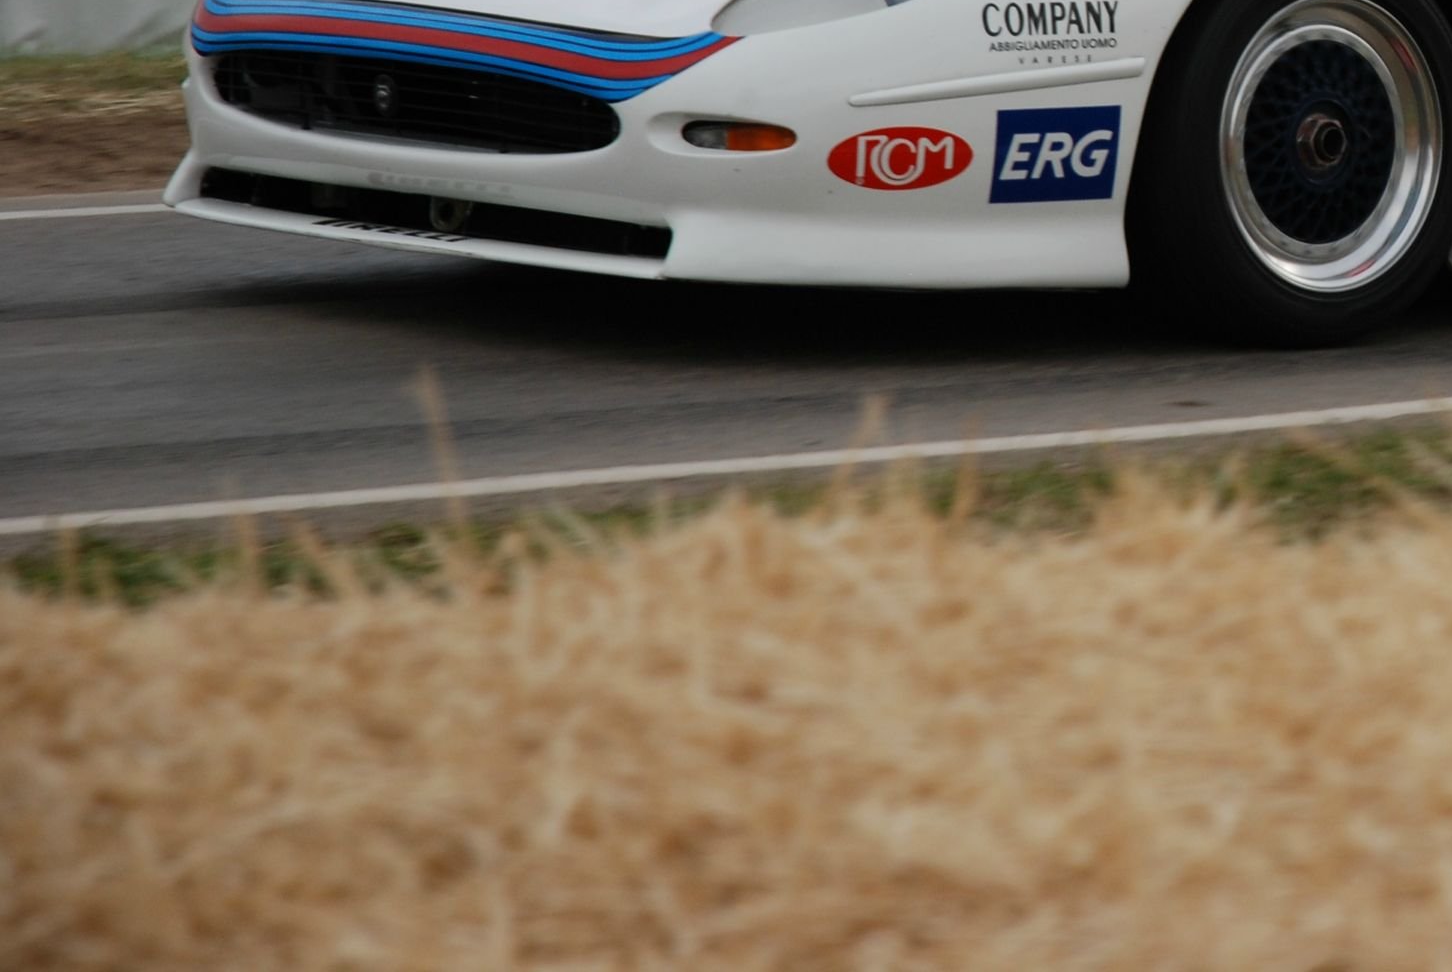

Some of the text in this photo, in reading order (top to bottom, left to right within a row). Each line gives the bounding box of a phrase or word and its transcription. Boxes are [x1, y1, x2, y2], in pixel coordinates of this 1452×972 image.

[982, 0, 1118, 37] COMPANY
[989, 37, 1118, 52] ABBIGLIAMENTO UOMO
[856, 134, 955, 185] RCM
[999, 130, 1114, 180] ERG
